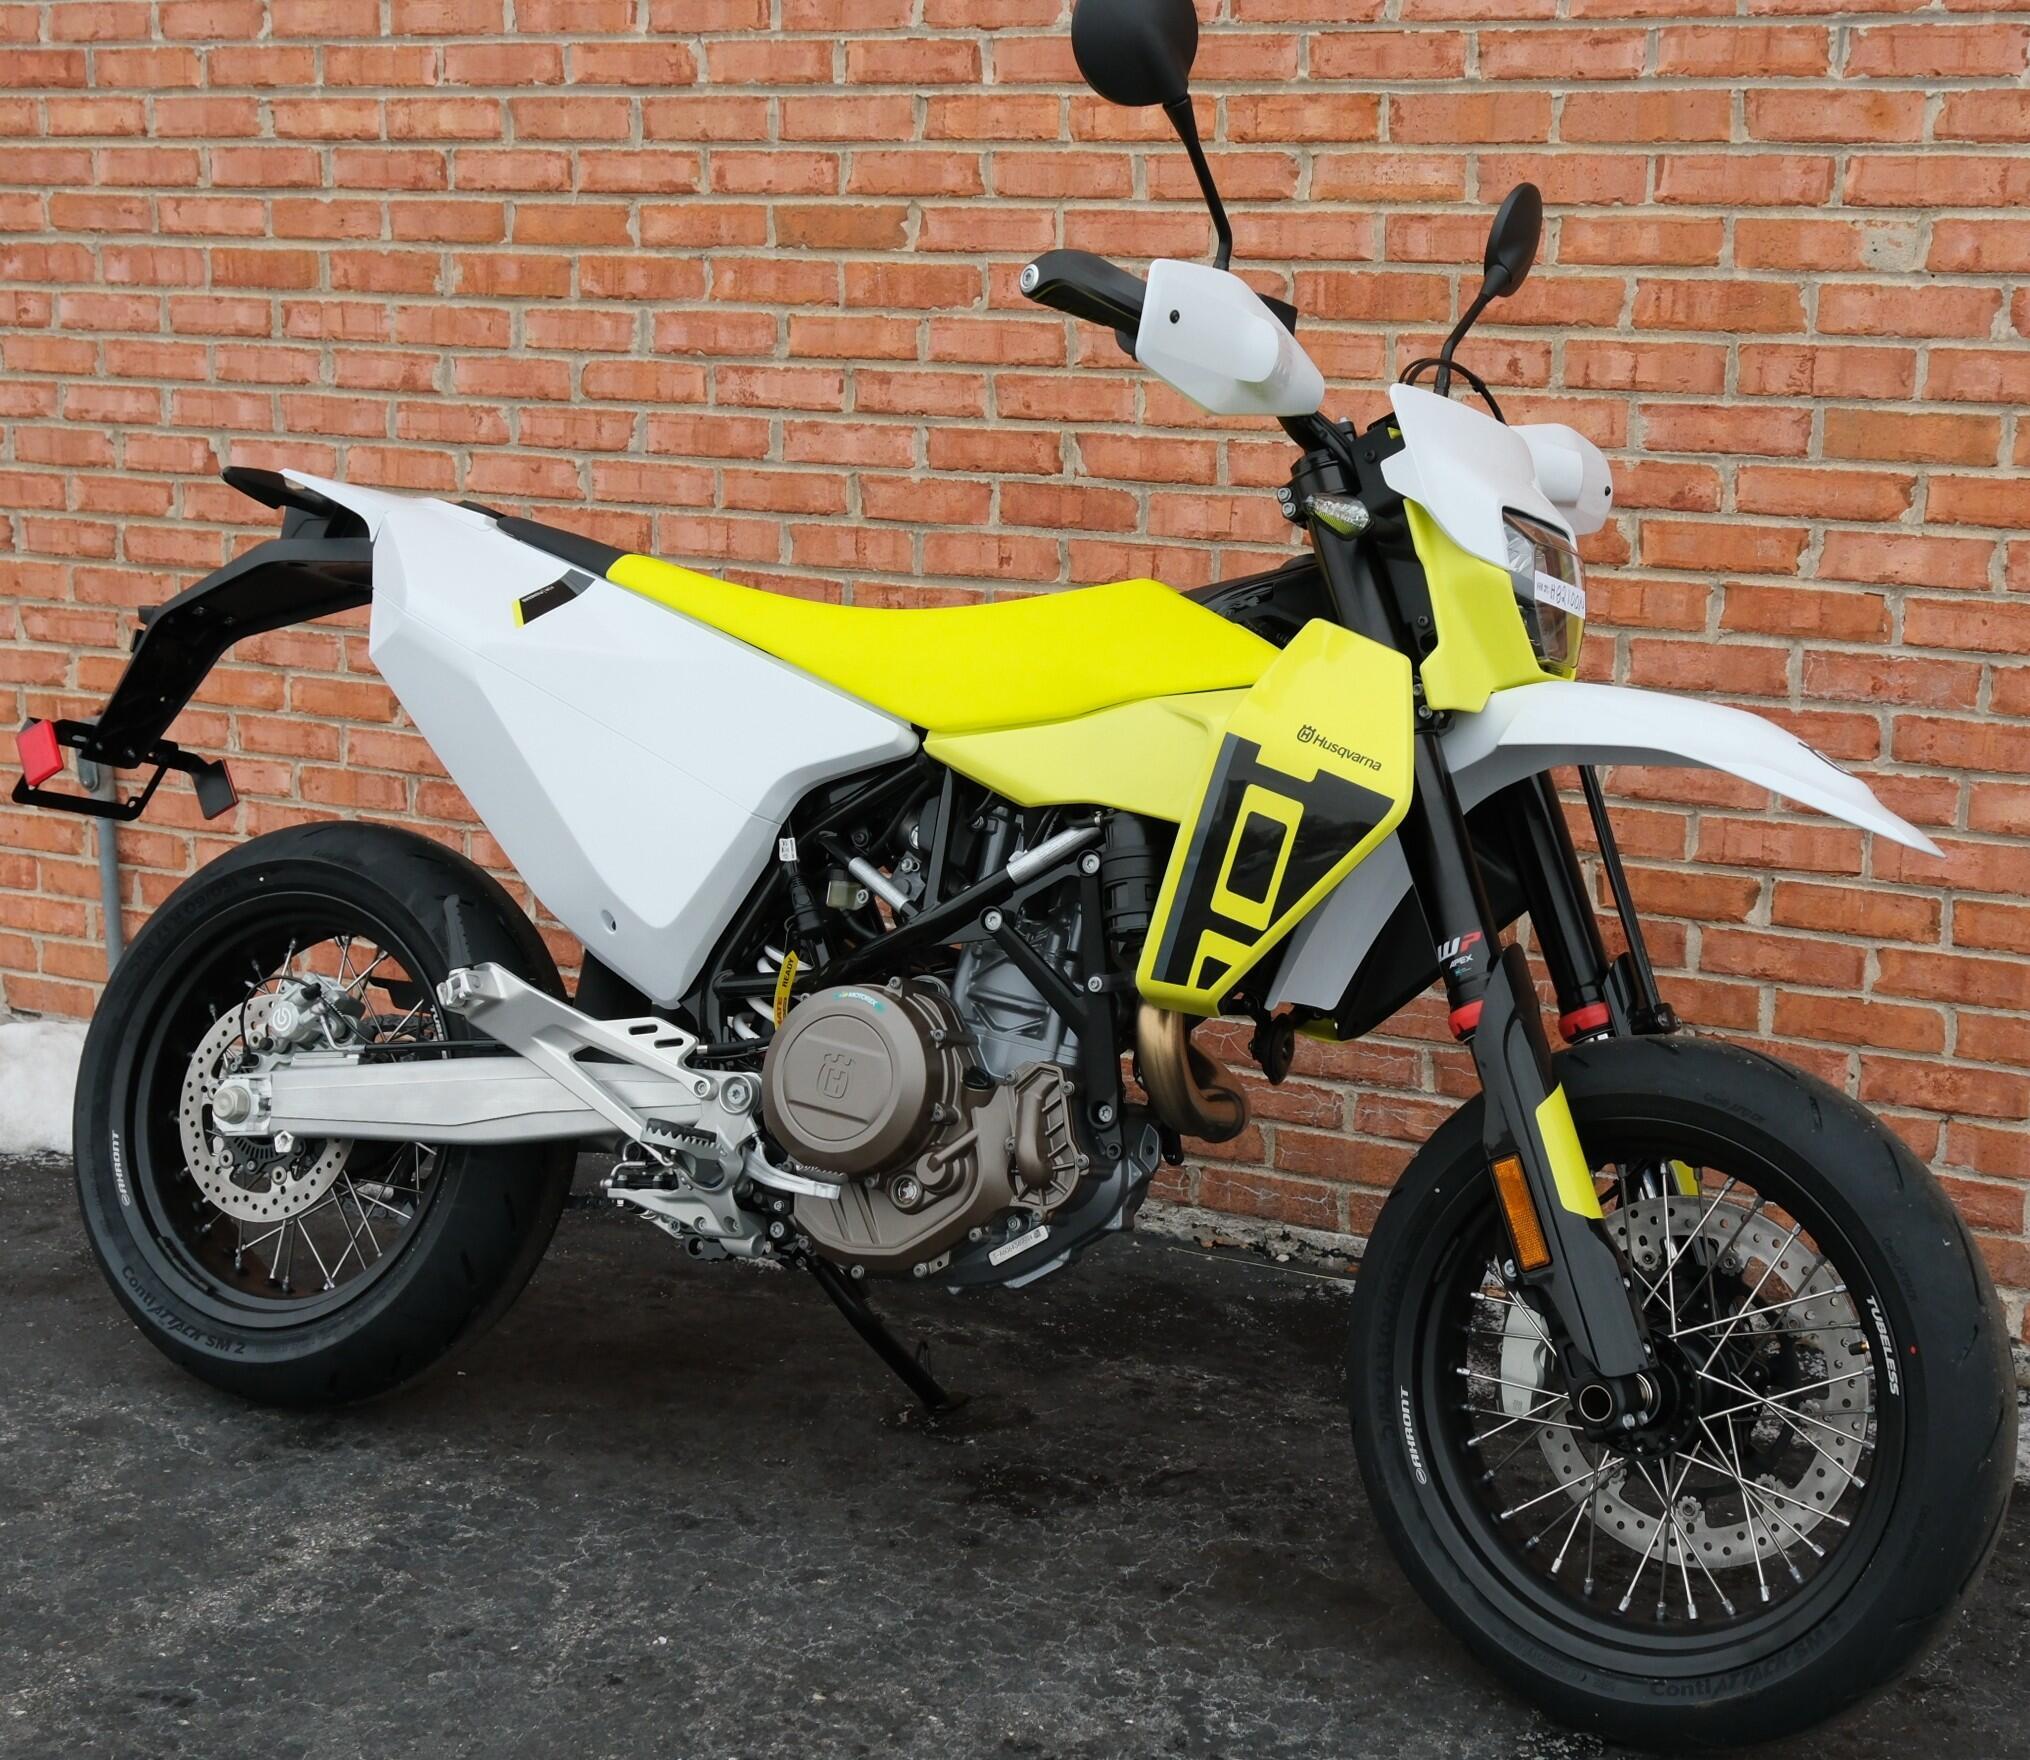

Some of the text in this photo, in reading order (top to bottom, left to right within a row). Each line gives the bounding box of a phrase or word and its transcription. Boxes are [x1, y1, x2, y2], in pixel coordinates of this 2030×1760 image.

[1313, 735, 1382, 772] Husqvarna
[1437, 931, 1482, 962] WP
[1449, 953, 1474, 969] APEX
[782, 958, 795, 987] READY
[204, 1334, 232, 1353] SM
[234, 1343, 246, 1355] 2
[1866, 1295, 1899, 1397] TUBELESS
